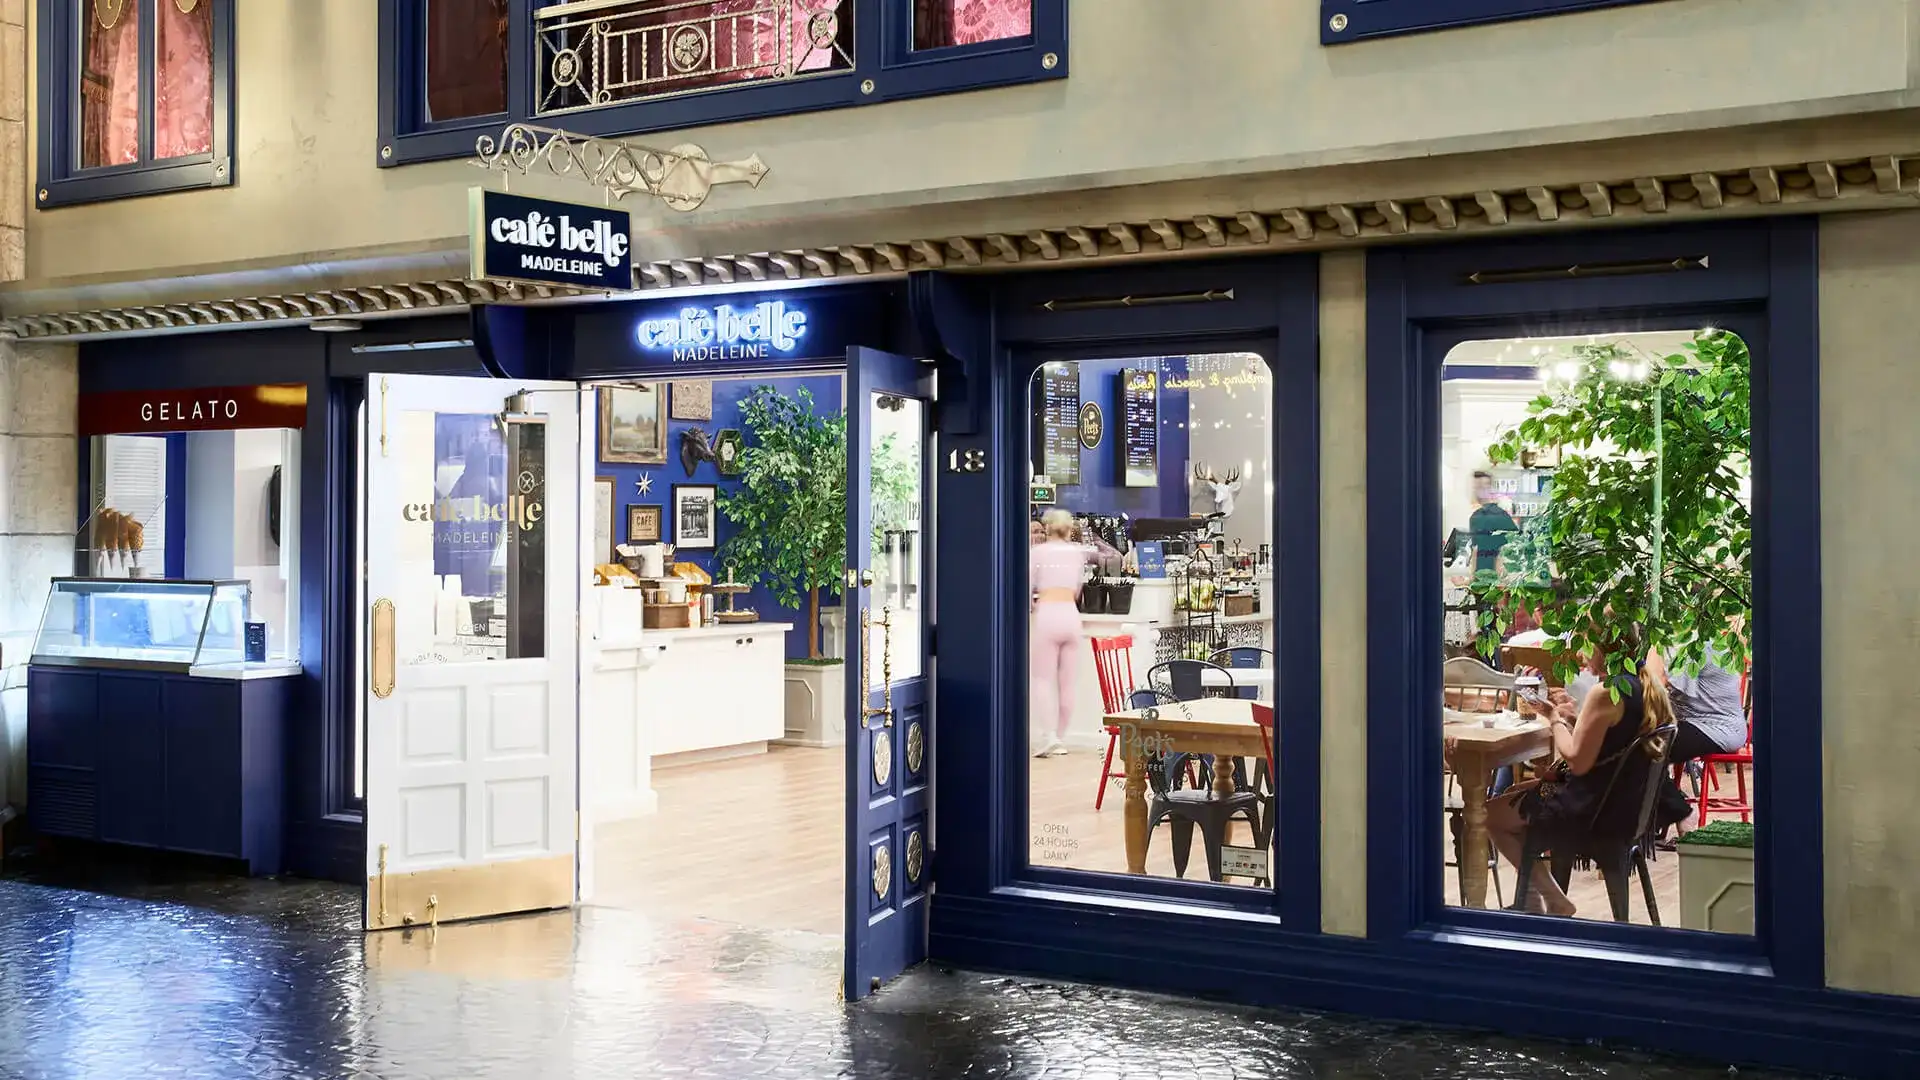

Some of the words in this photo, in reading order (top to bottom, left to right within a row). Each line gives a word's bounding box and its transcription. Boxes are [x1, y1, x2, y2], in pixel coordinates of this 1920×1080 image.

[491, 211, 555, 248] café
[559, 215, 628, 267] belle
[521, 254, 603, 276] MADELEINE
[637, 306, 714, 348] café
[714, 300, 807, 351] belle
[673, 344, 769, 362] MADELEINE
[141, 399, 238, 421] GELATO
[947, 448, 985, 473] 18
[1119, 722, 1176, 762] Peet's
[1134, 762, 1164, 773] OFFEE
[1043, 823, 1069, 834] OPEN
[1033, 837, 1045, 846] 24
[1047, 837, 1079, 849] HOURS
[1043, 850, 1069, 860] DAILY
